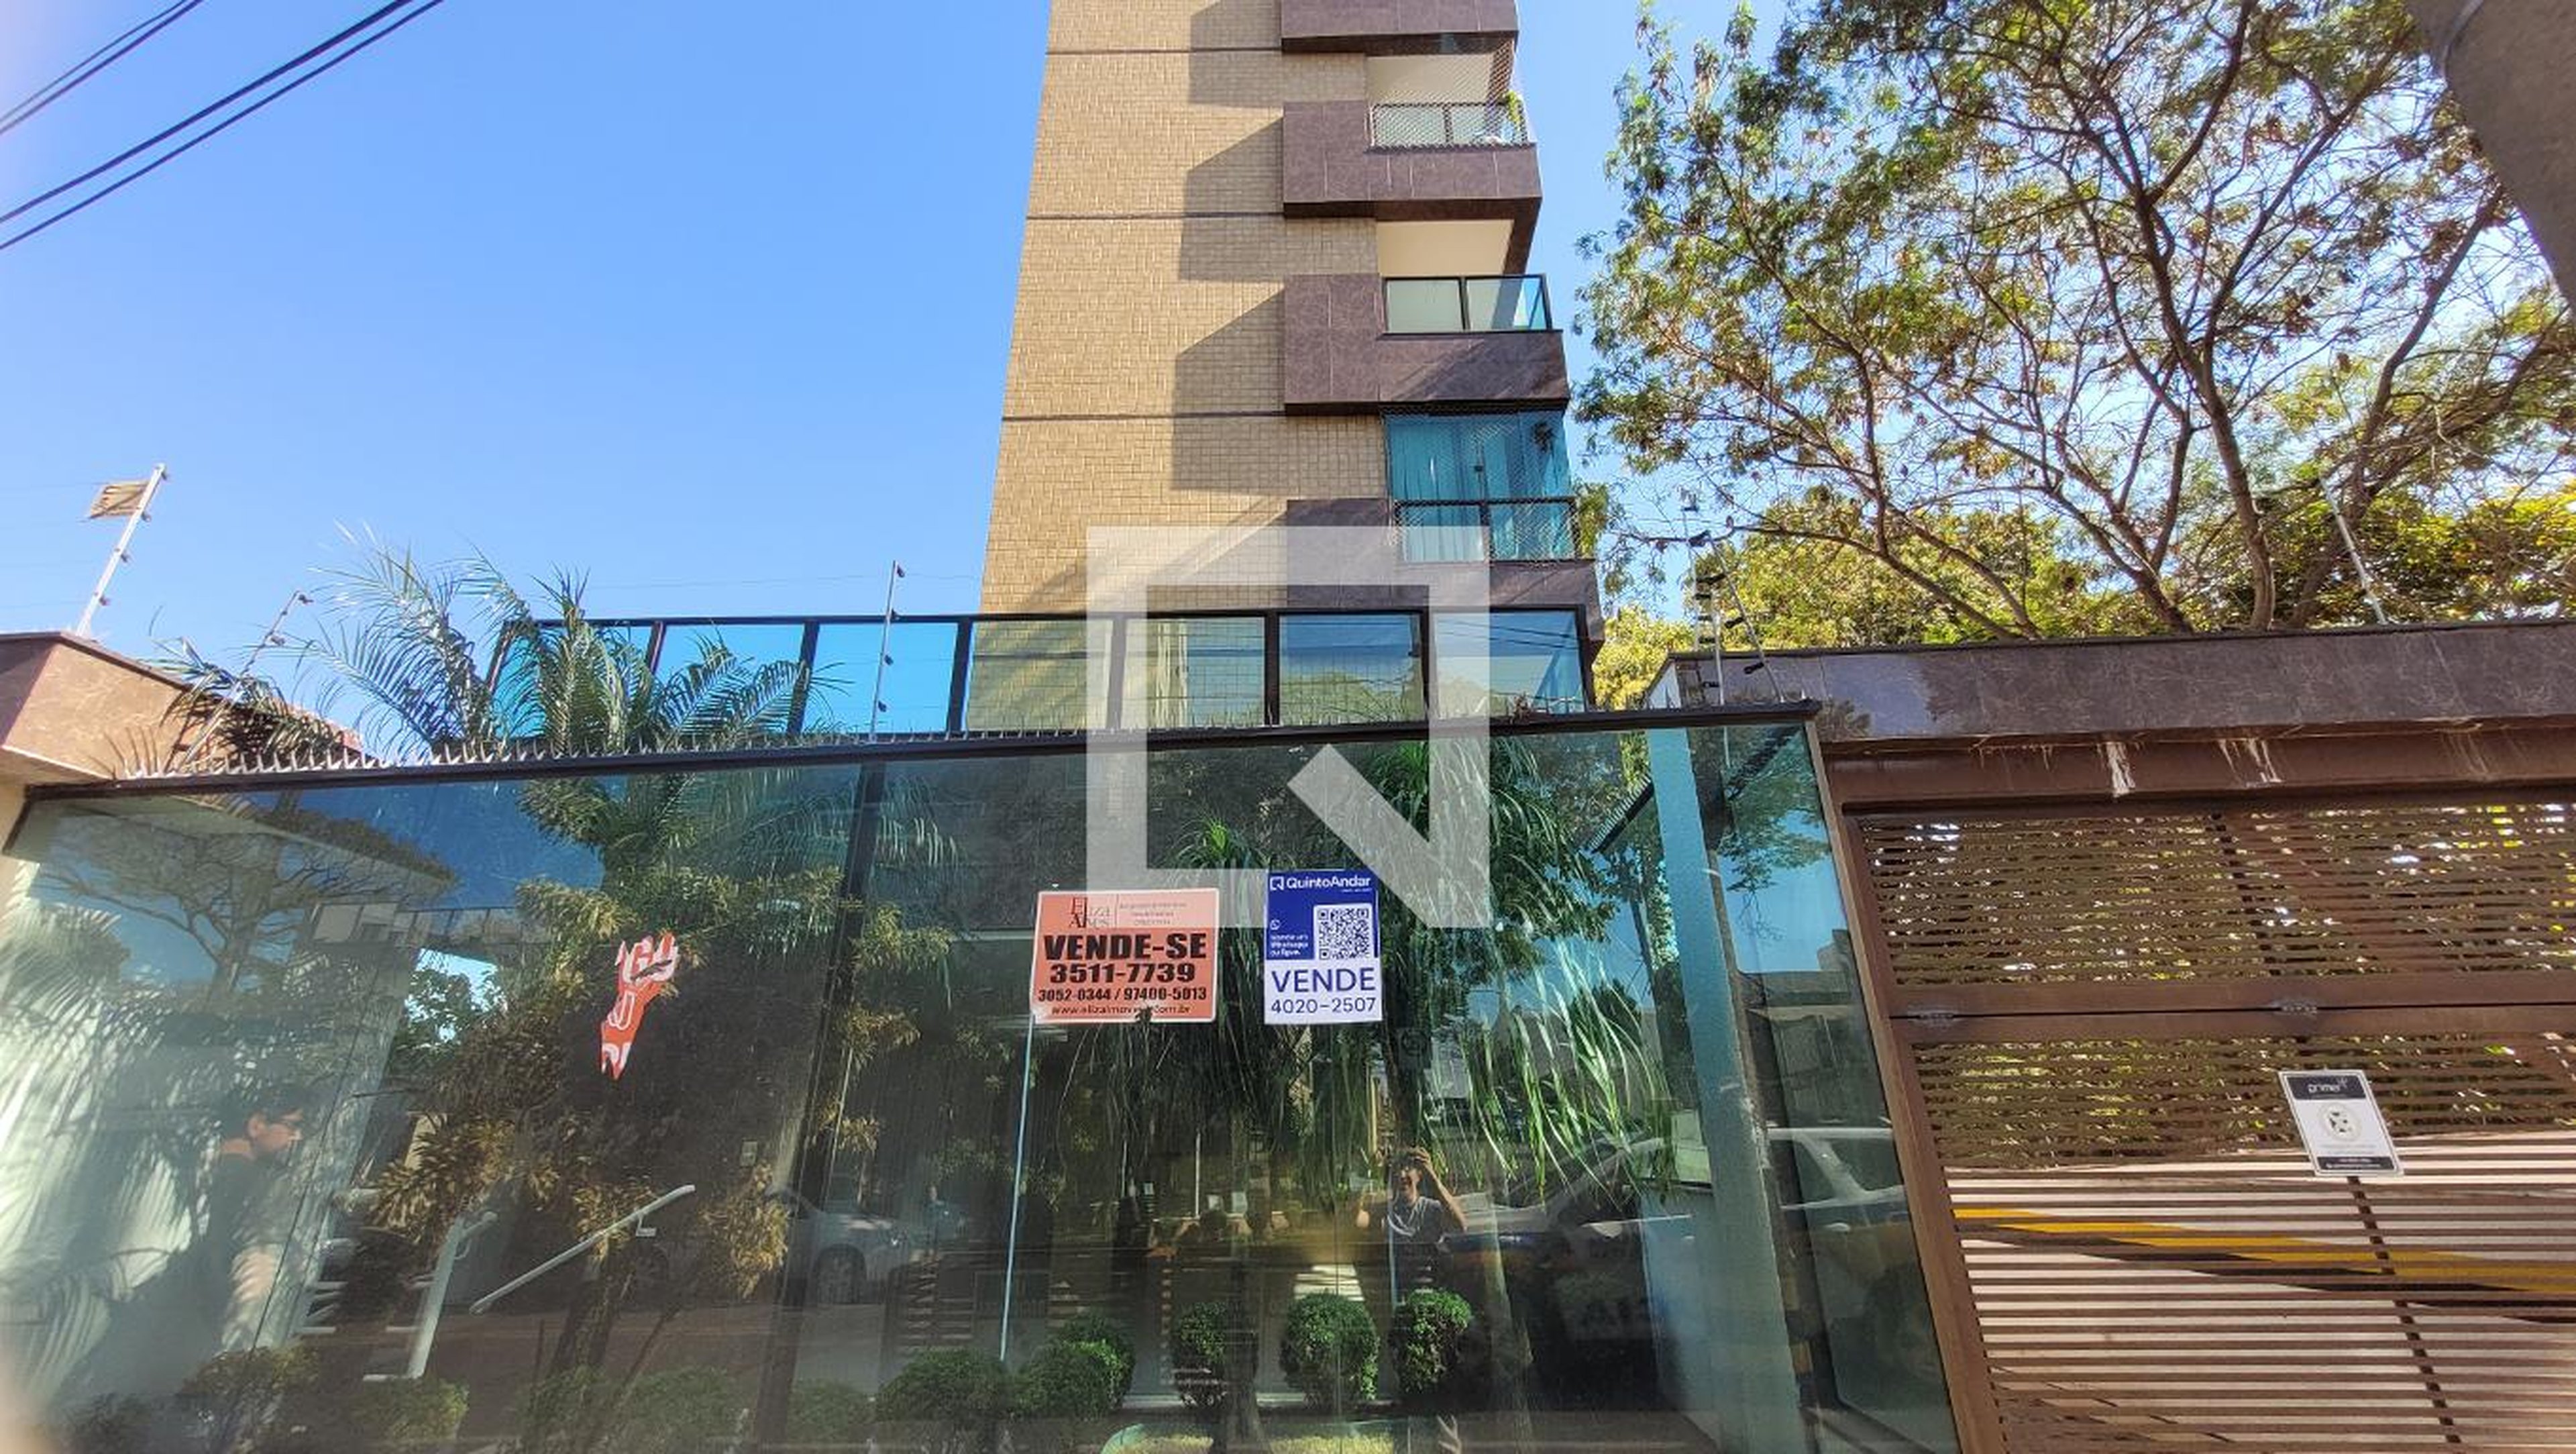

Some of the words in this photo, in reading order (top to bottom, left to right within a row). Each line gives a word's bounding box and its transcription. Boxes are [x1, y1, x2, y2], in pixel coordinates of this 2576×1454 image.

[1286, 874, 1371, 889] QuintoAndar
[1043, 933, 1207, 960] VENDE-SE
[1050, 962, 1195, 984] 3511-7739
[1271, 968, 1375, 993] VENDE
[1038, 988, 1113, 1002] 3052-0344
[1114, 988, 1122, 1001] /
[1271, 997, 1377, 1014] 4020-2507
